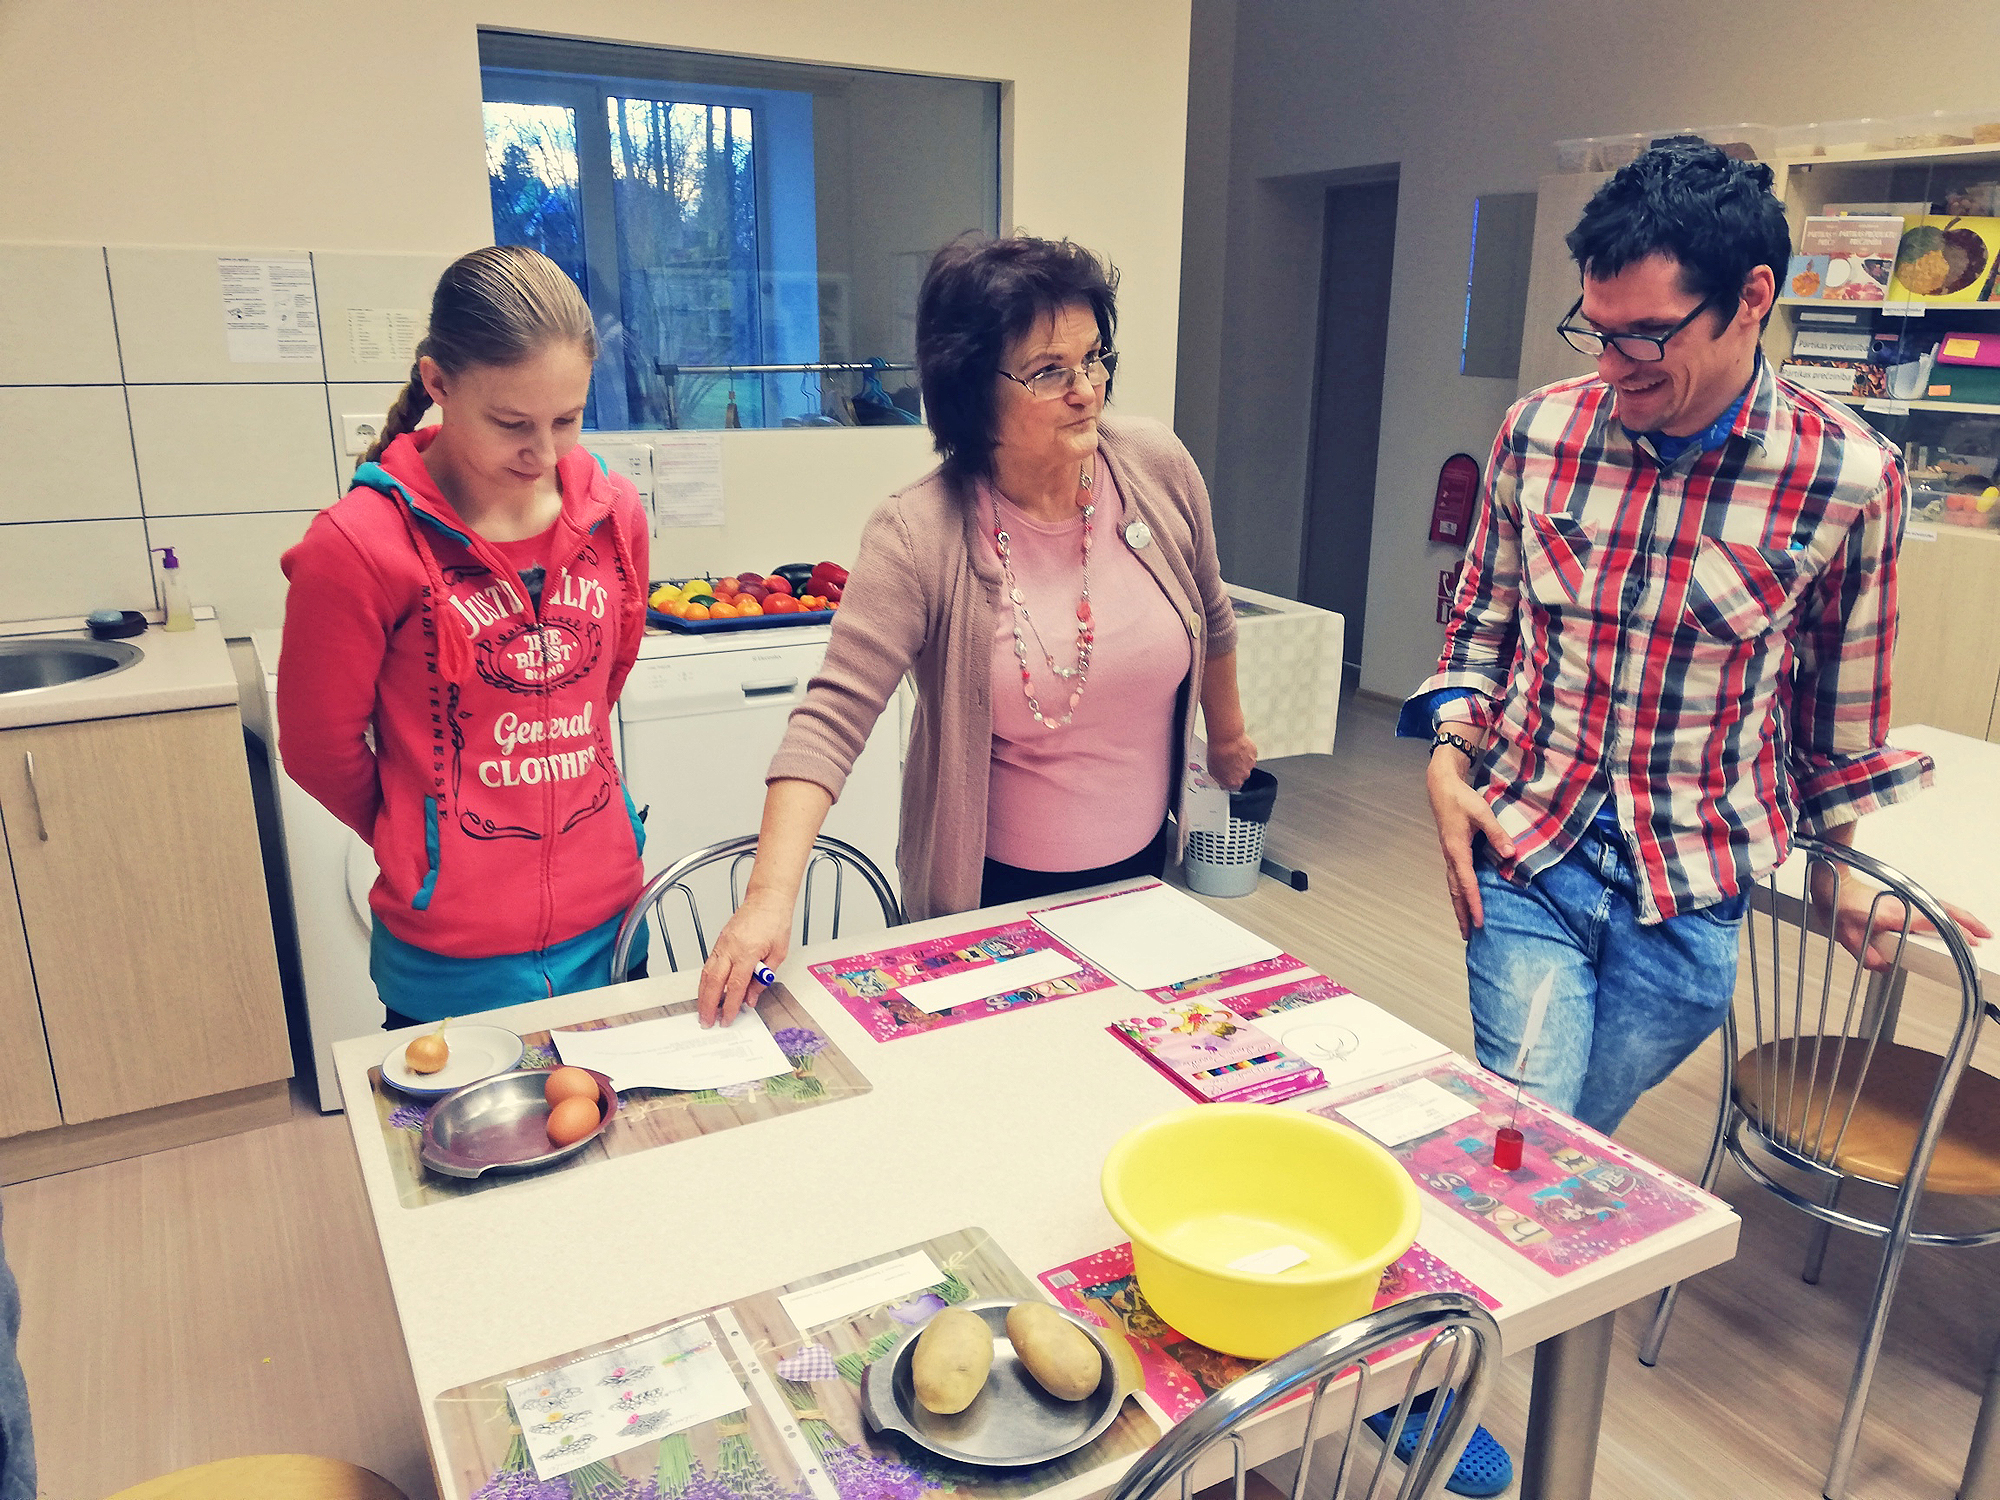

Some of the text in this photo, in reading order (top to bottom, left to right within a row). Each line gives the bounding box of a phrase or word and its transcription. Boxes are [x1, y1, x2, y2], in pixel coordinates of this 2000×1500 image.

[523, 629, 562, 651] THE
[421, 585, 449, 821] MADE IN TENNESSEE
[493, 701, 594, 756] General
